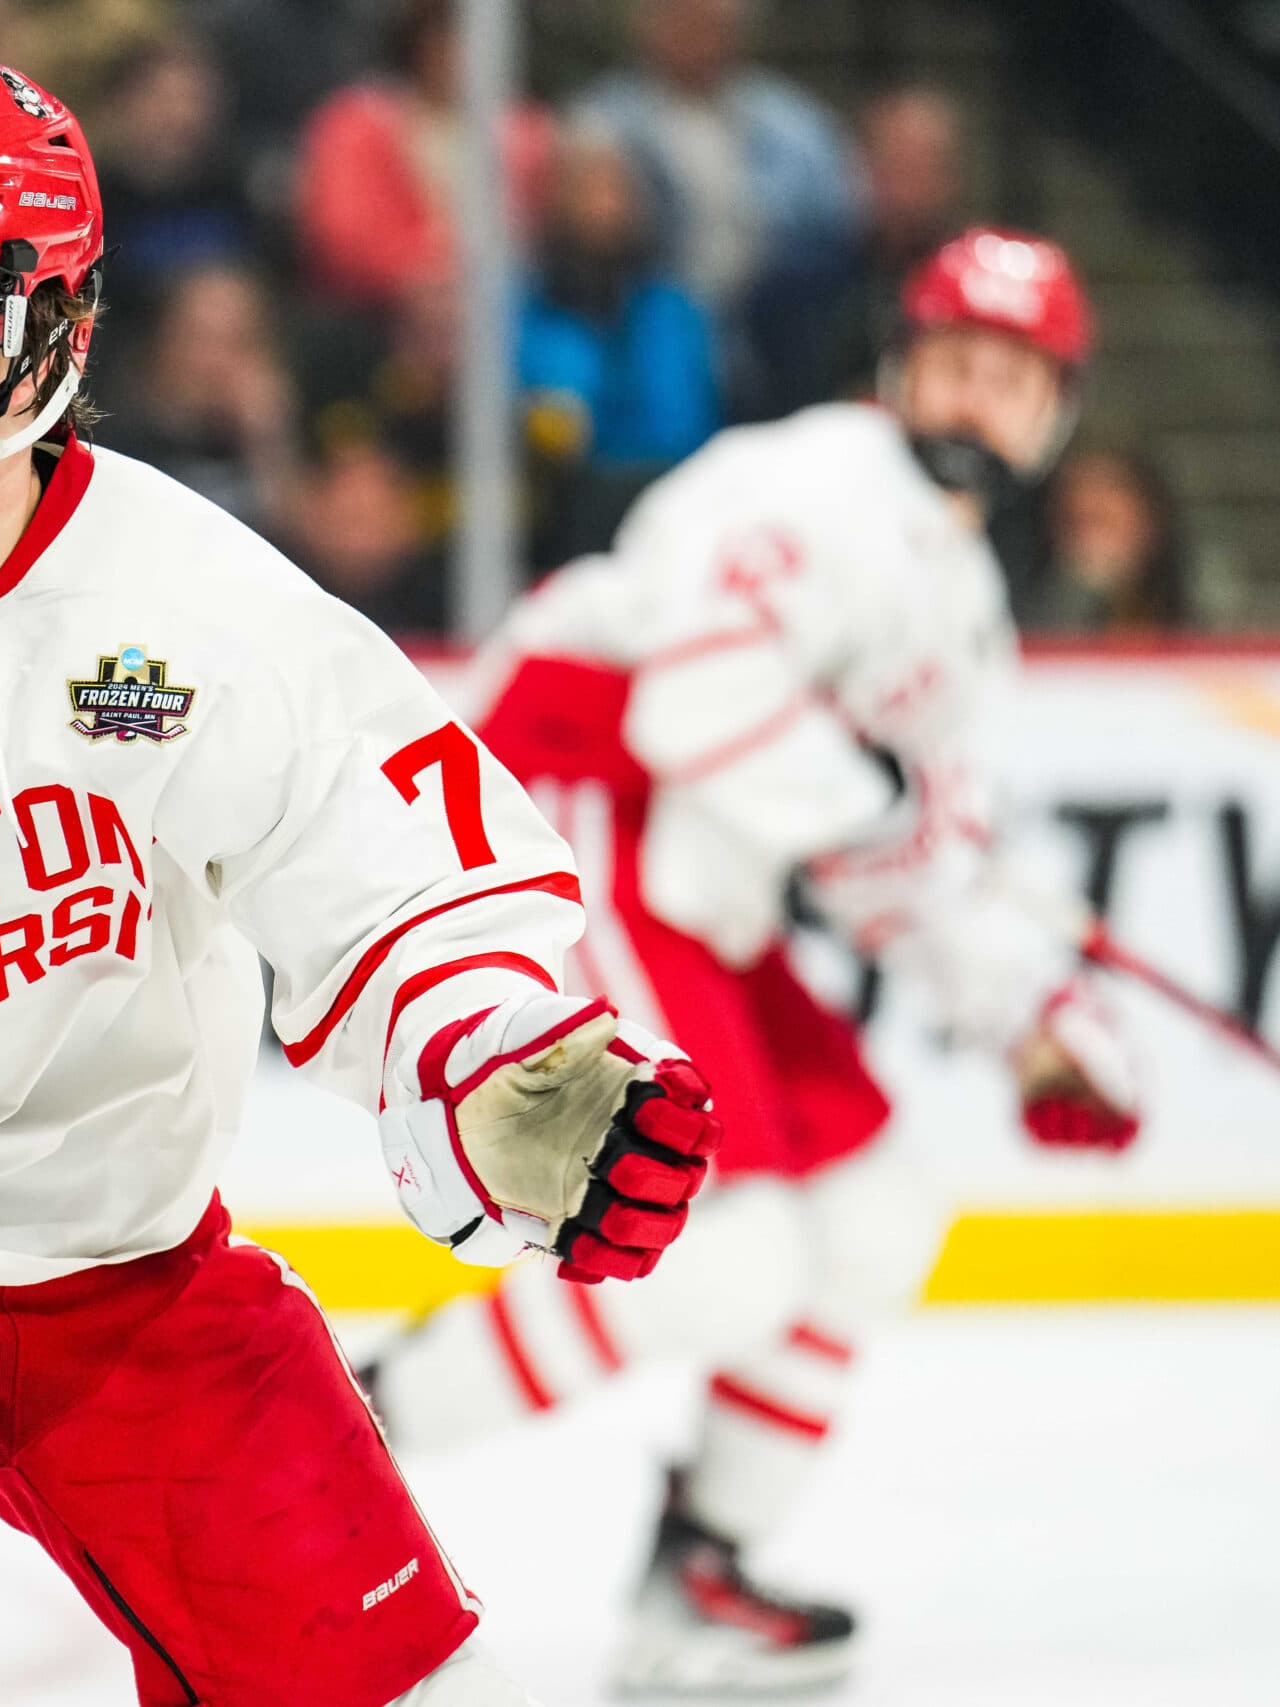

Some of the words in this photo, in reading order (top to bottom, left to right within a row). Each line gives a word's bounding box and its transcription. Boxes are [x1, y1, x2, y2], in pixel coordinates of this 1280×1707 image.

[78, 689, 140, 708] FROZEN
[141, 692, 185, 712] FOUR
[362, 1557, 419, 1612] BAUER
